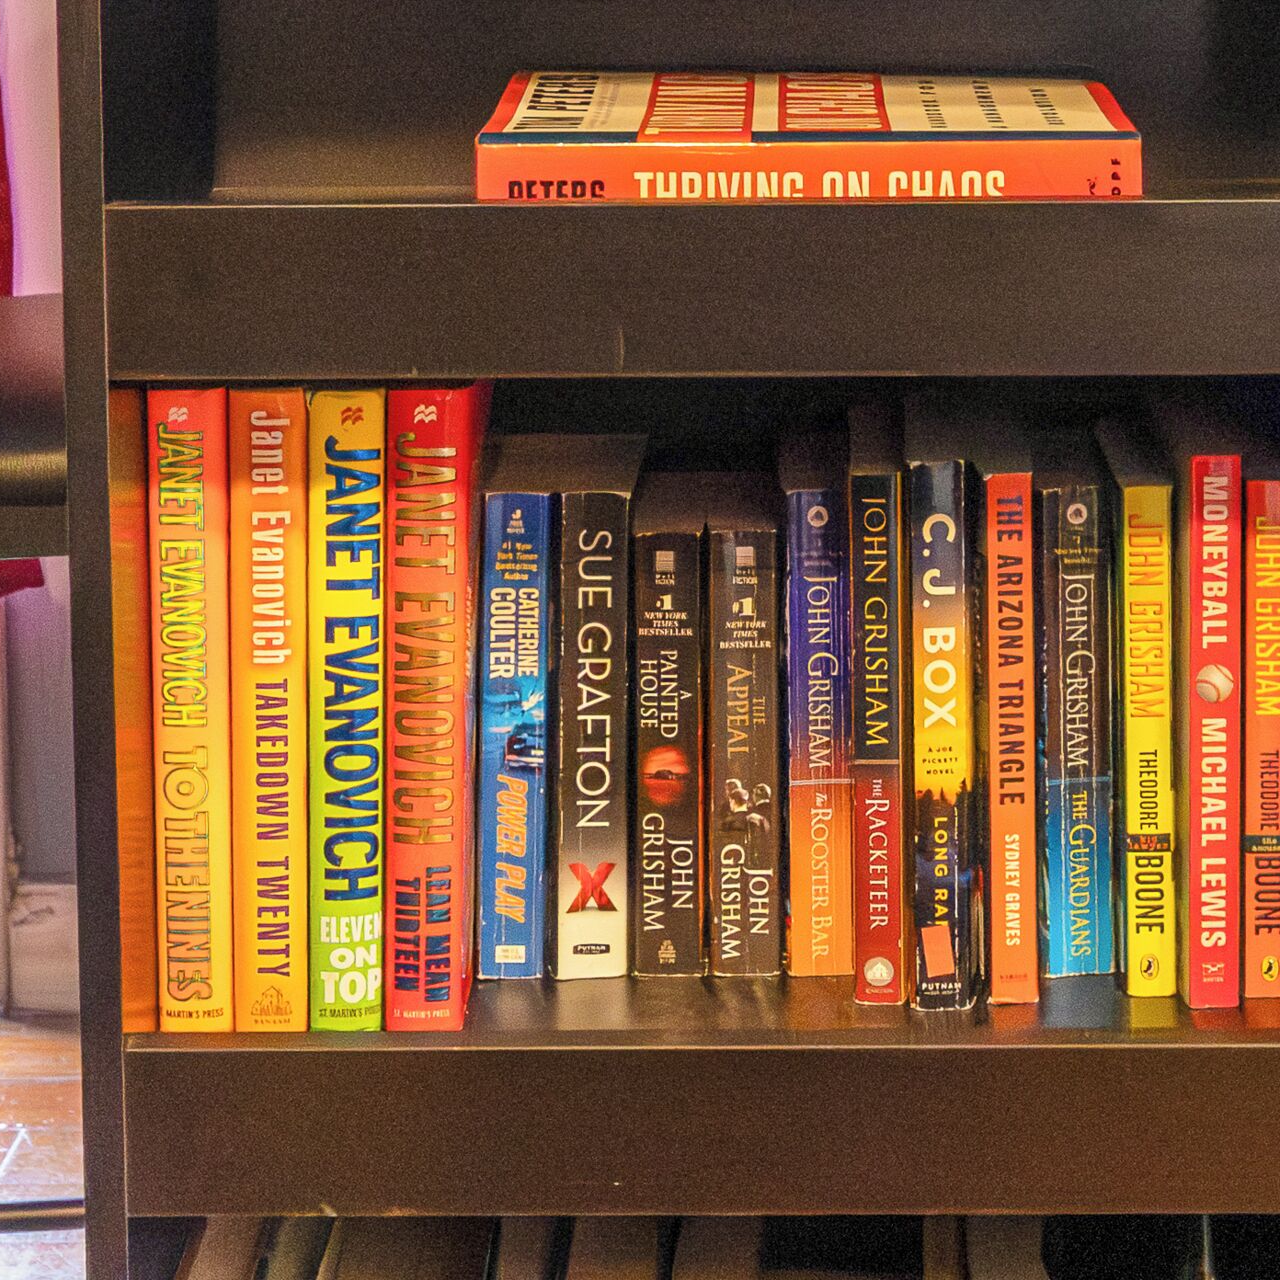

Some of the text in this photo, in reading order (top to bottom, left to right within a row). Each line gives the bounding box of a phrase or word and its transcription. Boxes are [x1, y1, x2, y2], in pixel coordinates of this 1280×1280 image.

[527, 75, 600, 112] PETERS
[644, 76, 748, 135] THRIVING
[785, 73, 884, 129] ON CHAOS
[634, 171, 804, 198] THRIVING
[822, 171, 871, 198] ON
[1202, 475, 1229, 649] MONEYBALL
[393, 431, 457, 846] JANET EVANOVICH
[489, 587, 516, 679] COULTER
[517, 587, 540, 677] CATHERINE
[638, 627, 694, 637] BESTSELLER
[720, 640, 772, 650] BESTSELLER
[732, 597, 756, 617] #1
[733, 630, 758, 639] TIMES
[803, 575, 838, 646] JOHN
[862, 498, 890, 747] JOHN GRISHAM
[1061, 573, 1096, 644] JOHN
[1128, 514, 1165, 719] JOHN GRISHAM
[323, 434, 383, 902] JANET EVANOVICH
[575, 528, 613, 829] SUE GRAFTON
[922, 627, 957, 729] BOX
[996, 495, 1026, 806] THE ARIZONA TRIANGLE
[156, 423, 214, 1001] JANET EVANOVICH TO THE NINES
[249, 411, 292, 978] Janet Evanovich TAKEDOWN TWENTY
[640, 659, 659, 728] HOUSE
[660, 650, 679, 738] PAINTED
[680, 689, 693, 700] A
[726, 663, 753, 759] APPEAL
[753, 695, 766, 725] THE
[807, 651, 839, 768] GRISHAM
[1063, 650, 1097, 767] GRISHAM
[496, 774, 527, 856] POWER
[1139, 748, 1159, 831] THEODORE
[1201, 716, 1228, 847] MICHAEL
[1259, 749, 1280, 831] THEODORE
[566, 860, 619, 914] X
[642, 813, 665, 932] GRISHAM
[665, 837, 694, 910] JOHN
[810, 807, 833, 911] ROOSTER
[866, 779, 891, 929] THE RACKETEER
[934, 817, 949, 878] LONG
[1005, 832, 1022, 946] SYDNEY GRAVES
[1068, 791, 1097, 957] THE GUARDIANS
[321, 911, 382, 943] ELEVEN
[393, 876, 422, 993] THIRTEEN
[424, 865, 452, 1003] LEAN MEAN
[494, 862, 527, 924] PLAY
[720, 843, 746, 960] GRISHAM
[742, 867, 774, 935] JOHN
[1134, 855, 1165, 935] BOONE
[1200, 857, 1227, 947] LEWIS
[329, 944, 377, 969] ON
[811, 916, 833, 959] BAR
[321, 970, 382, 1004] TOP
[922, 982, 962, 990] PUTNAM
